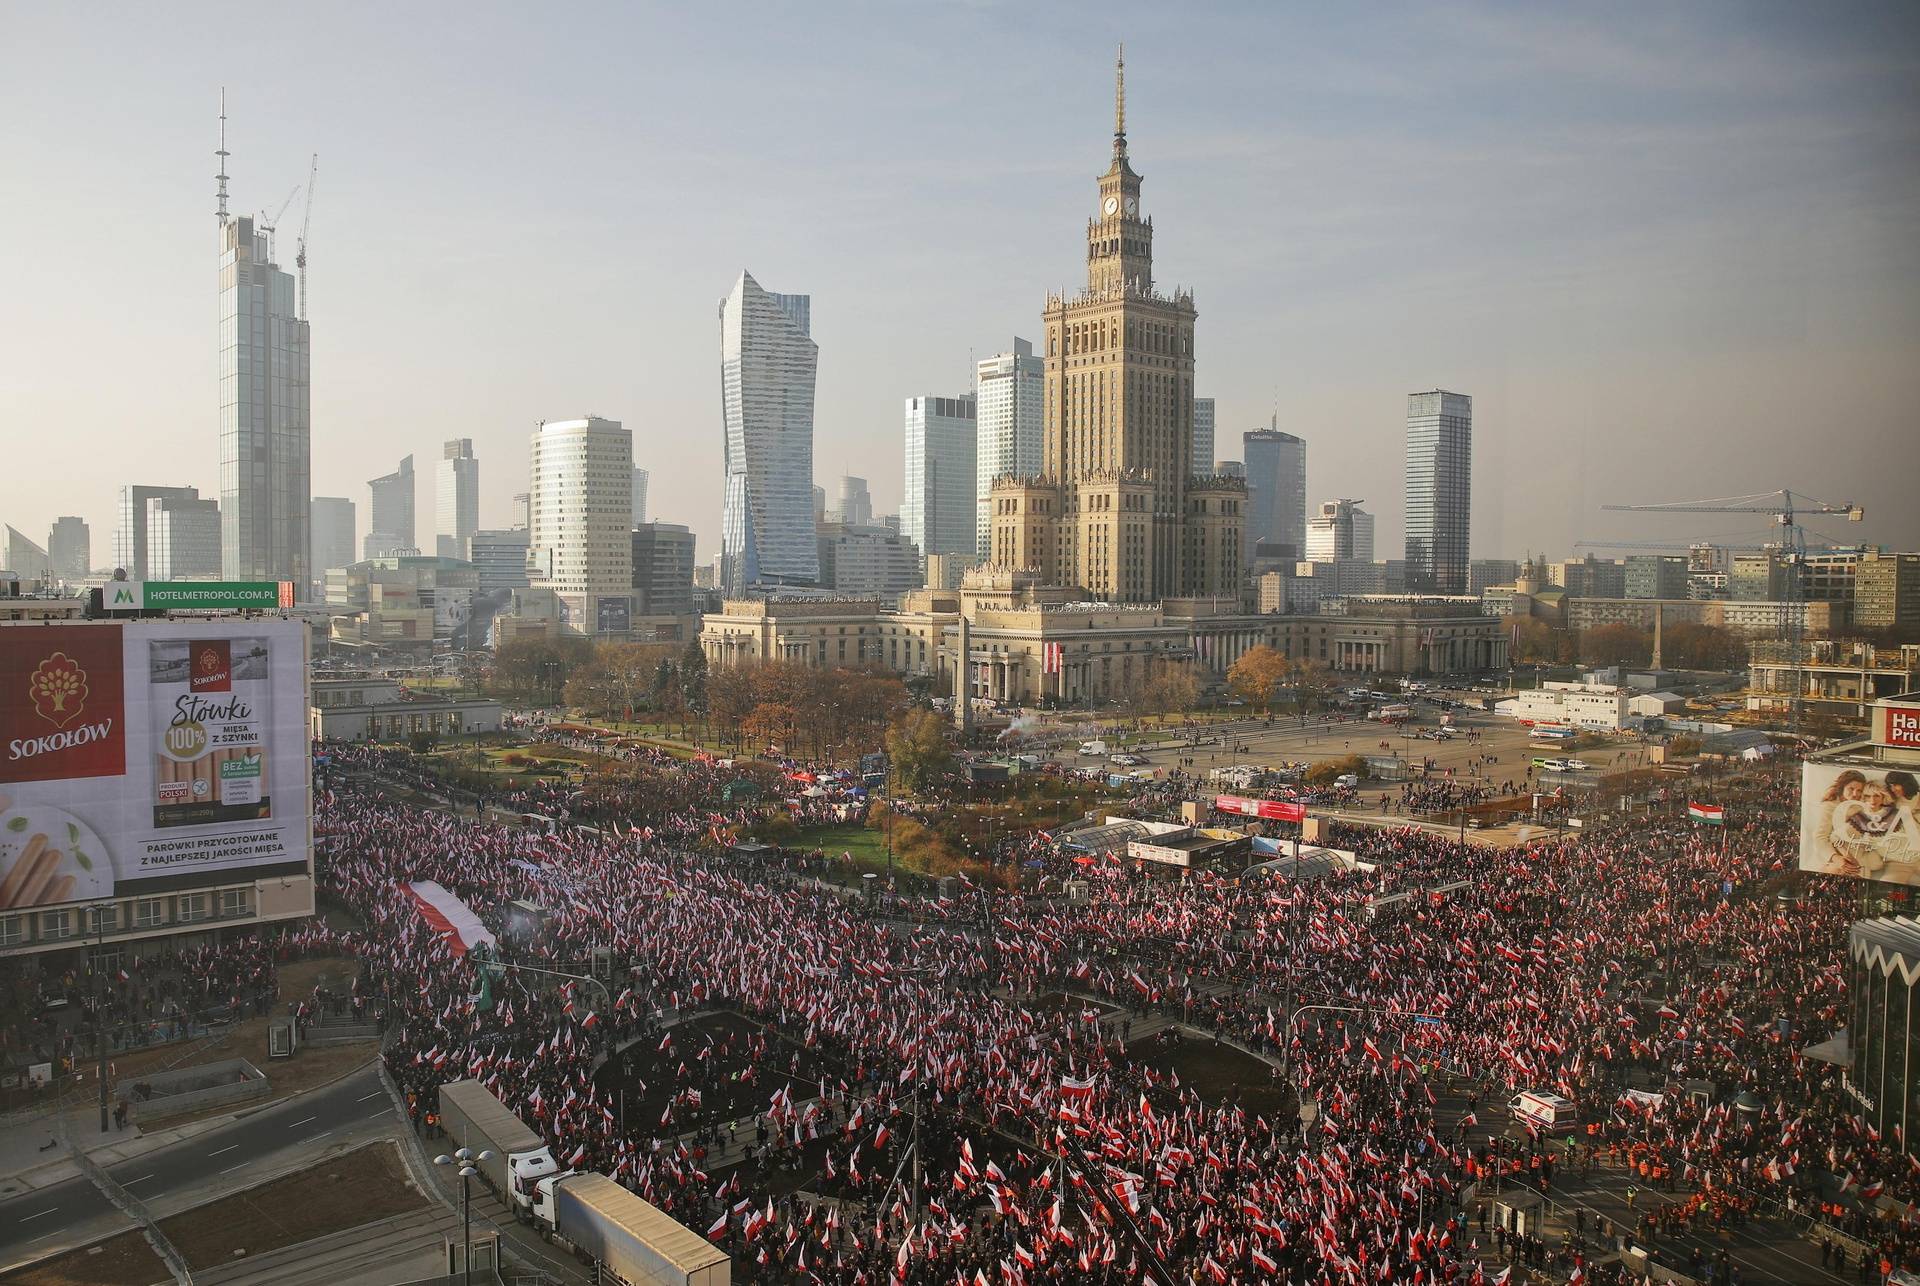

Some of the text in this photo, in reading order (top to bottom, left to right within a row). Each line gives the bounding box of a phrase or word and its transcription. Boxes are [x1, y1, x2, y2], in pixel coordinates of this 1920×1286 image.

[151, 590, 275, 600] HOTELMETROPOL.COM.PL
[171, 694, 252, 727] Stówki
[1892, 713, 1920, 729] Ha
[223, 725, 249, 734] MIĘSA
[8, 718, 112, 760] SOKOŁÓW
[212, 732, 258, 743] Z SZYNKI
[223, 762, 243, 772] BEZ
[160, 790, 187, 799] POLSKI
[197, 832, 278, 847] PRZYGOTOWANE
[141, 857, 148, 865] Z
[151, 851, 210, 865] NAJLEPSZEJ
